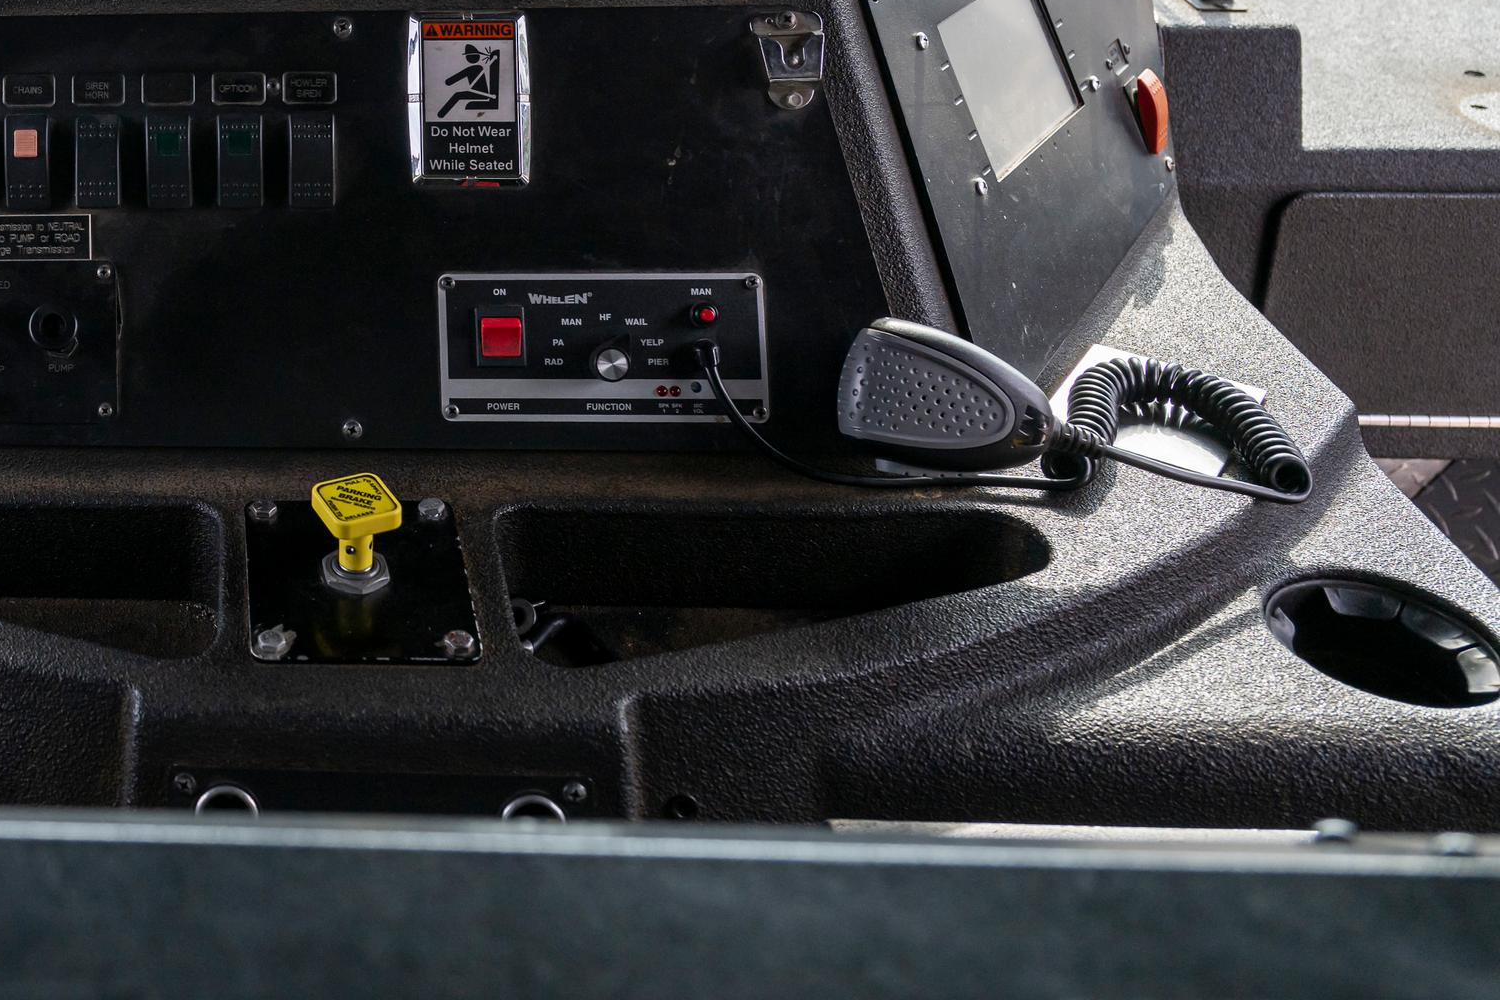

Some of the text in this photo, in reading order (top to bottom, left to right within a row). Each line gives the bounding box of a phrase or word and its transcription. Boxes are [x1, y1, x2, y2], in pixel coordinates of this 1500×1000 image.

[440, 25, 512, 37] WARNING
[84, 81, 109, 90] SIREN
[290, 78, 328, 87] HOWLER
[13, 85, 44, 94] CHAINS
[296, 89, 323, 97] SIREN
[84, 91, 109, 100] HORN
[431, 126, 512, 137] Do Not Wear
[450, 143, 494, 154] Helmet
[429, 159, 513, 170] While Seated
[36, 223, 44, 231] to
[48, 222, 85, 231] NEUTRAL
[10, 233, 36, 243] PUMP
[40, 235, 49, 243] or
[54, 233, 81, 243] ROAD
[17, 244, 76, 255] Transmission
[493, 288, 507, 296] ON
[690, 287, 712, 296] MAN
[599, 313, 611, 321] HF
[625, 317, 649, 326] WAIL
[561, 318, 582, 326] MAN
[552, 338, 565, 347] PA
[640, 338, 664, 347] YELP
[544, 358, 564, 366] RAD
[647, 358, 669, 366] PIER
[47, 363, 76, 373] PUMP
[487, 402, 521, 411] POWER
[586, 402, 632, 411] FUNCTION
[336, 485, 382, 501] PARKING
[338, 492, 374, 506] BRAKE
